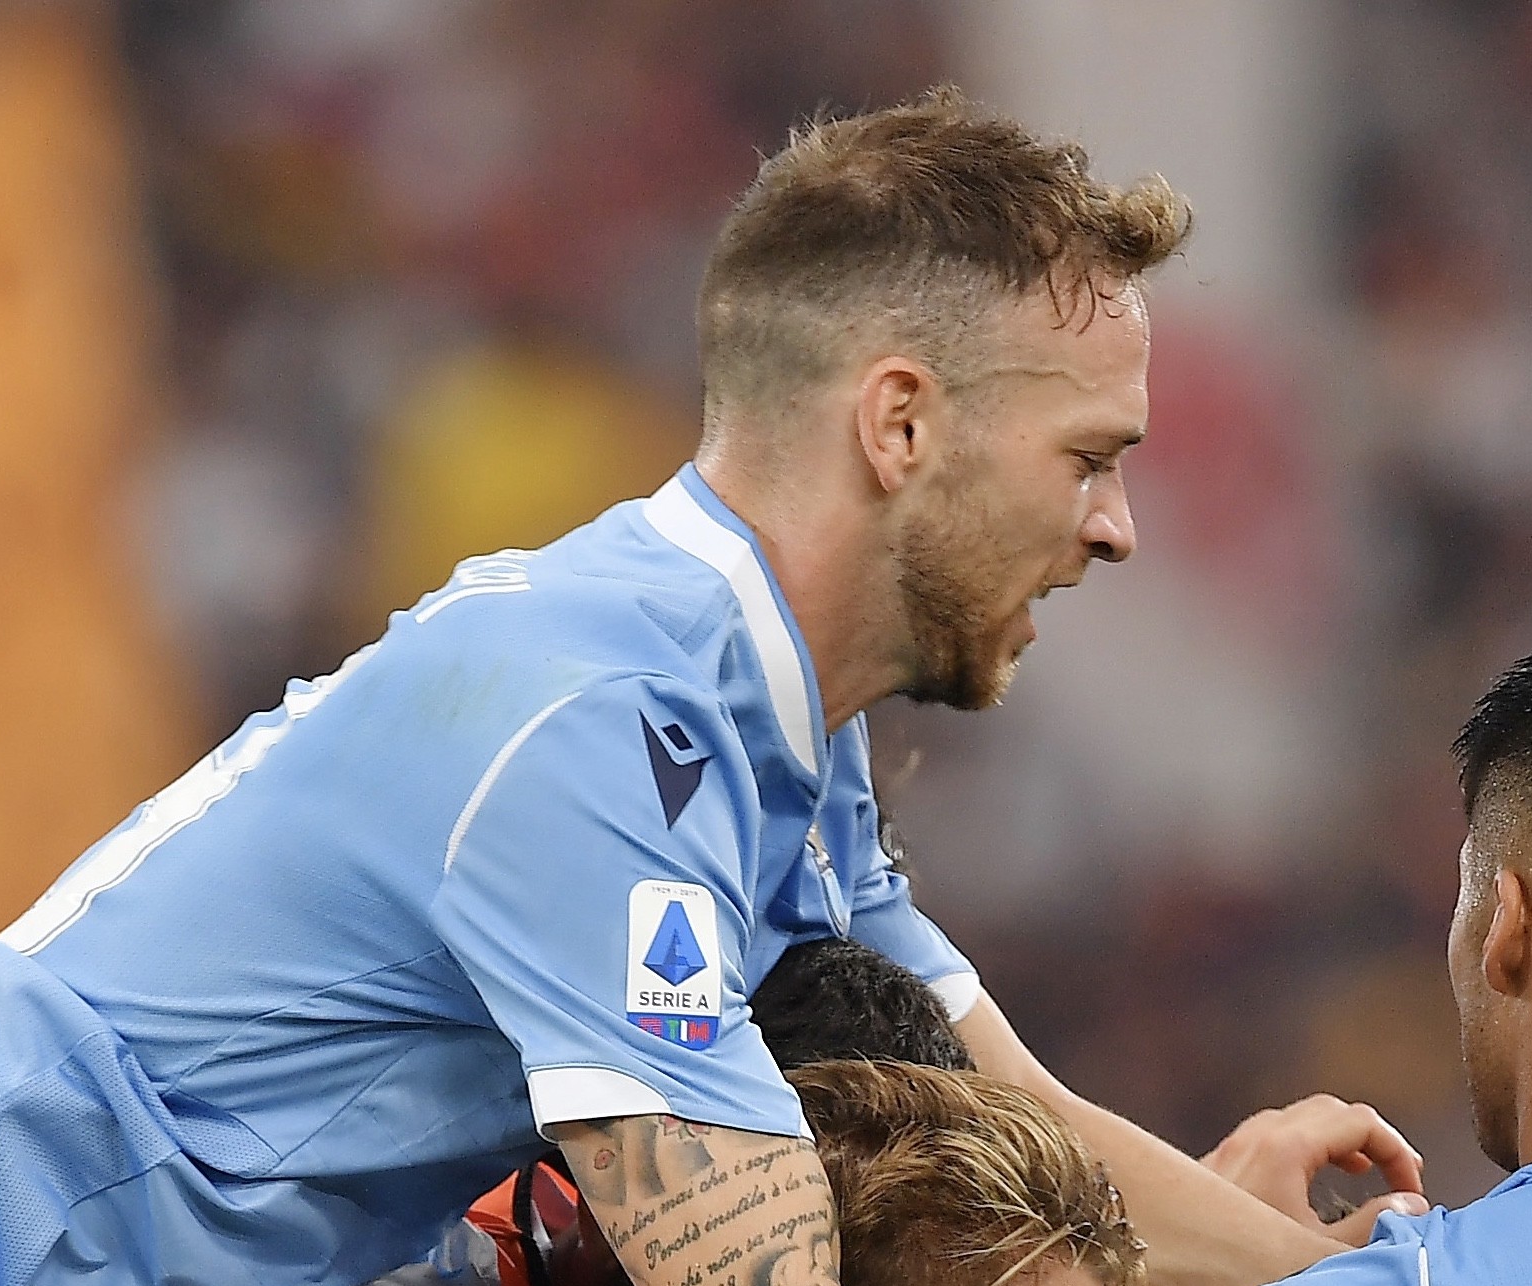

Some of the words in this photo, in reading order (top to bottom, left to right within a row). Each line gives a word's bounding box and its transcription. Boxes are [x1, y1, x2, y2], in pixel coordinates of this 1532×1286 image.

[638, 990, 692, 1009] SERIE
[697, 993, 710, 1010] A
[666, 1018, 710, 1043] TIM
[660, 1180, 694, 1215] mai
[699, 1166, 728, 1193] che
[745, 1143, 791, 1174] sogni
[785, 1171, 800, 1192] la
[746, 1233, 764, 1253] sa
